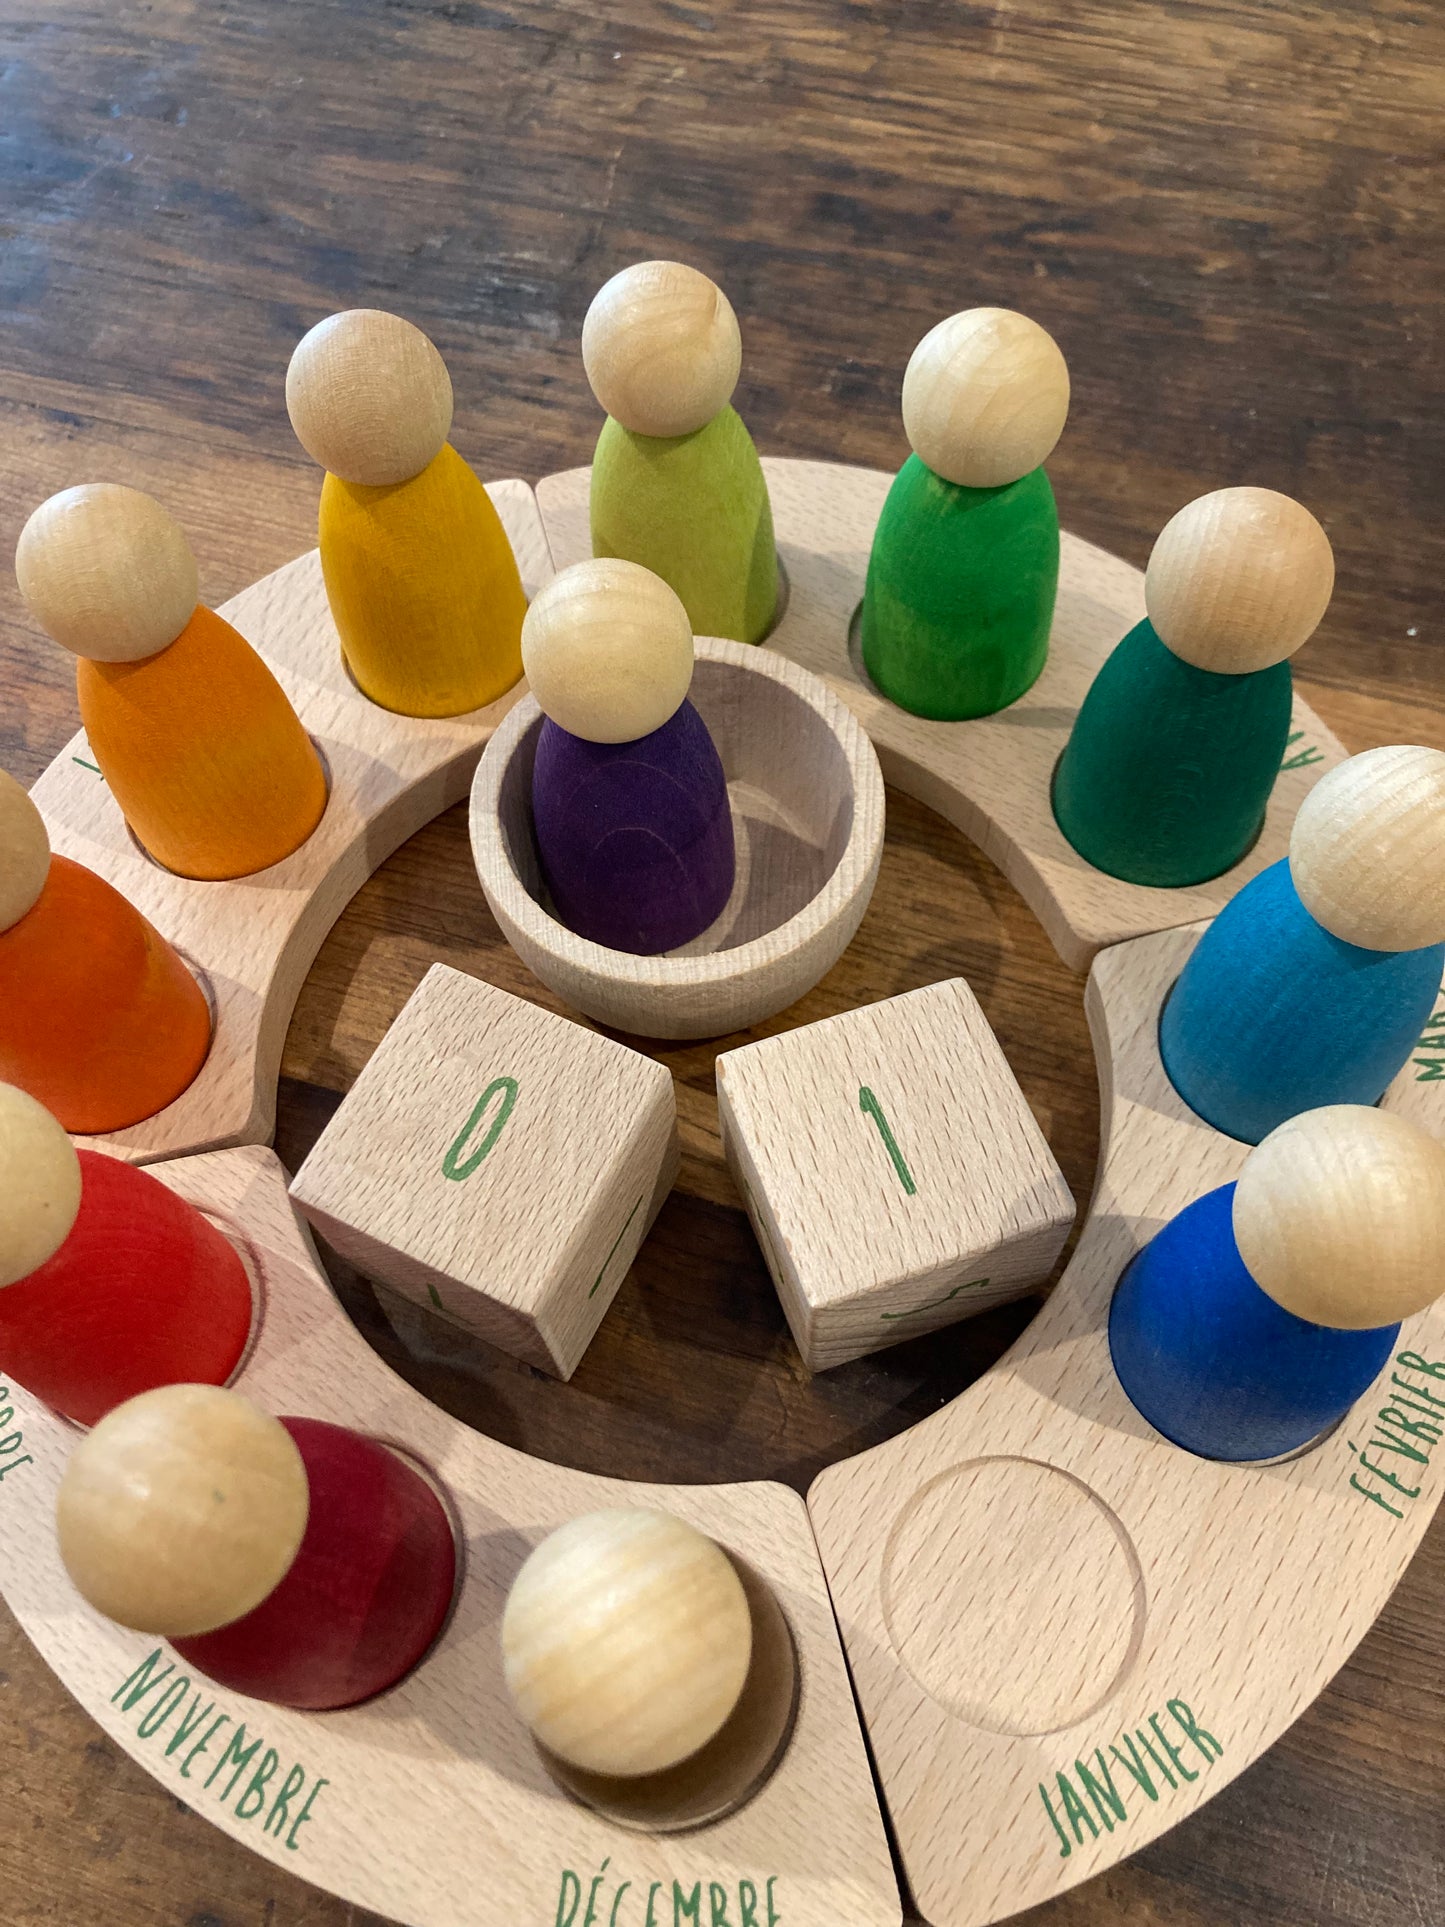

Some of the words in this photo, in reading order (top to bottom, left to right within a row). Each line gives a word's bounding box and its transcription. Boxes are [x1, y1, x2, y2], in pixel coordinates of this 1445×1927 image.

[441, 1076, 519, 1182] 0
[858, 1086, 917, 1196] 1
[1347, 1350, 1445, 1519] FÉVRIER
[111, 1647, 329, 1851] NOVEMBRE
[1038, 1699, 1224, 1858] JANVIER
[556, 1856, 782, 1927] DÉCEMBRE
